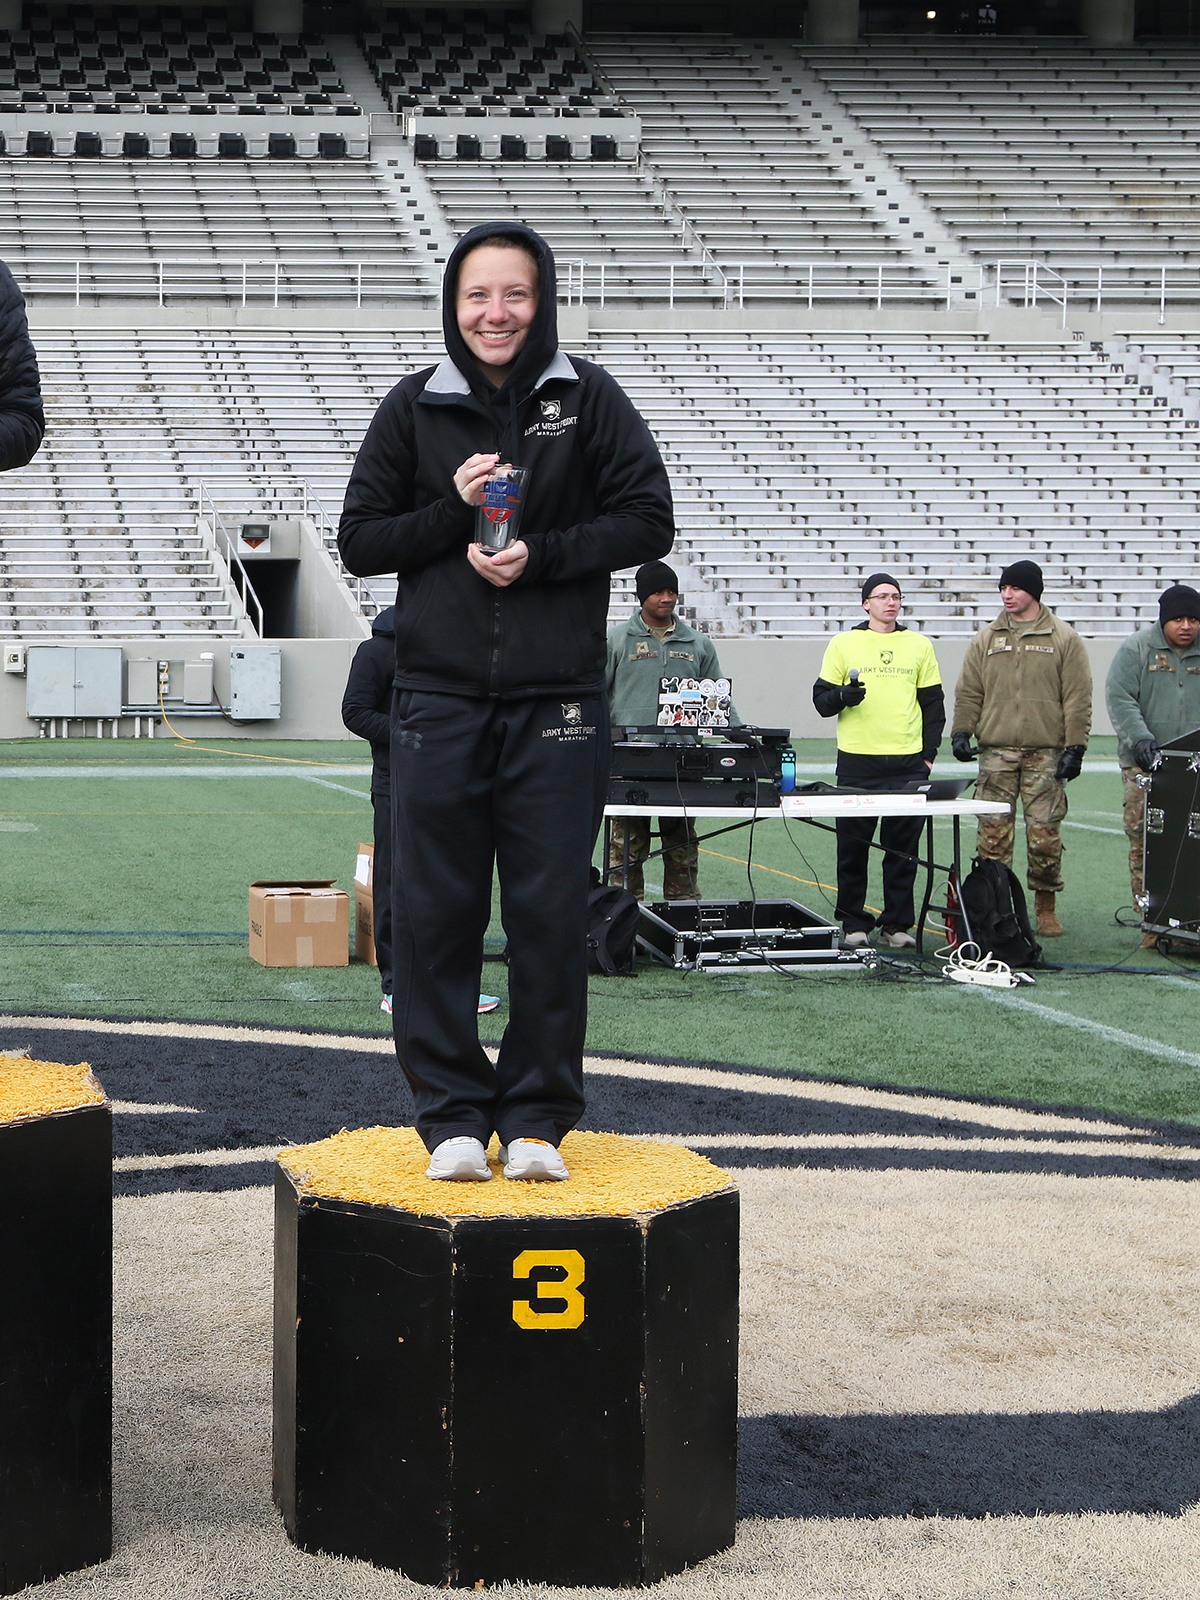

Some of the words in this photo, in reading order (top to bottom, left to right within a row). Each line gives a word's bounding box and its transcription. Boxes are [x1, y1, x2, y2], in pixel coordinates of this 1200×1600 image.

[524, 422, 540, 436] ARMY
[541, 422, 561, 430] WEST
[896, 667, 914, 675] POINT
[541, 728, 562, 738] ARMY
[563, 727, 583, 735] WEST
[512, 1249, 586, 1330] 3
